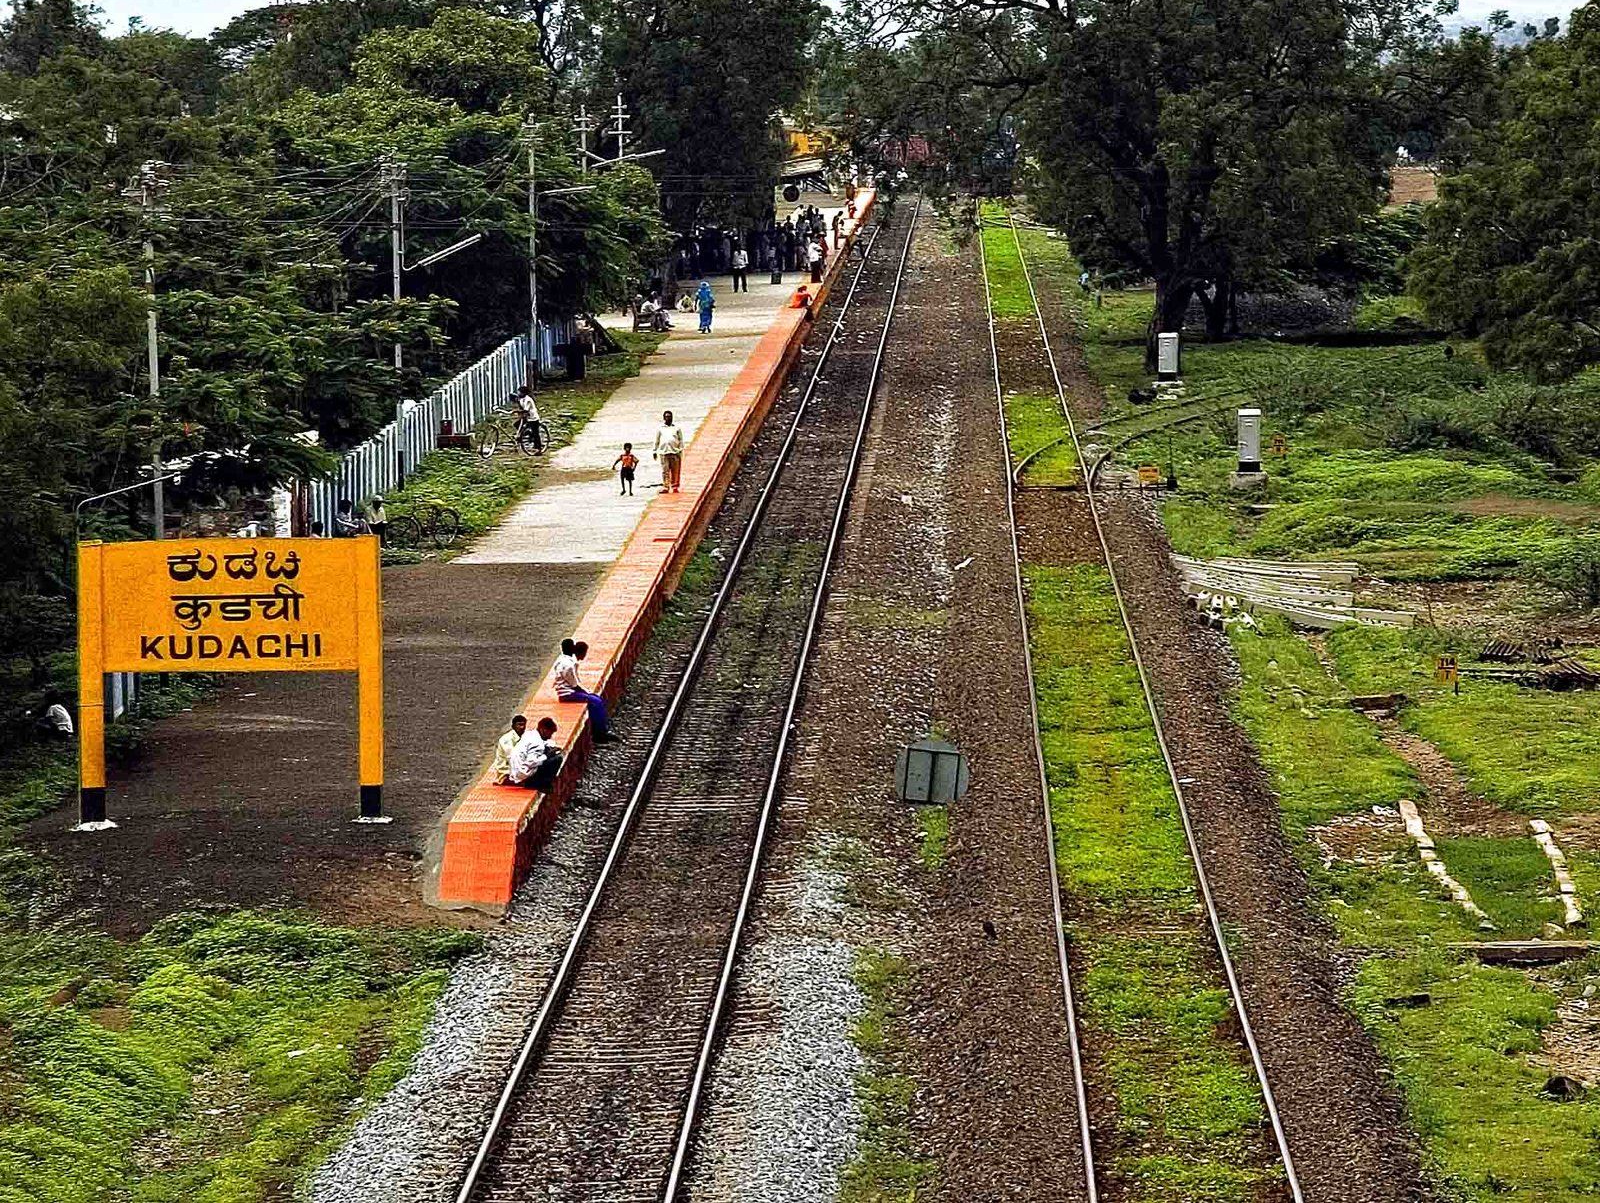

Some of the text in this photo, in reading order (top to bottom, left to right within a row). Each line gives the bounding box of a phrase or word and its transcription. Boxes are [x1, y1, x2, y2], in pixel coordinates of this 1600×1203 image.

[167, 547, 301, 581] ಕುಡಚಿ
[170, 583, 304, 630] कुडची
[141, 633, 321, 659] KUDACHI
